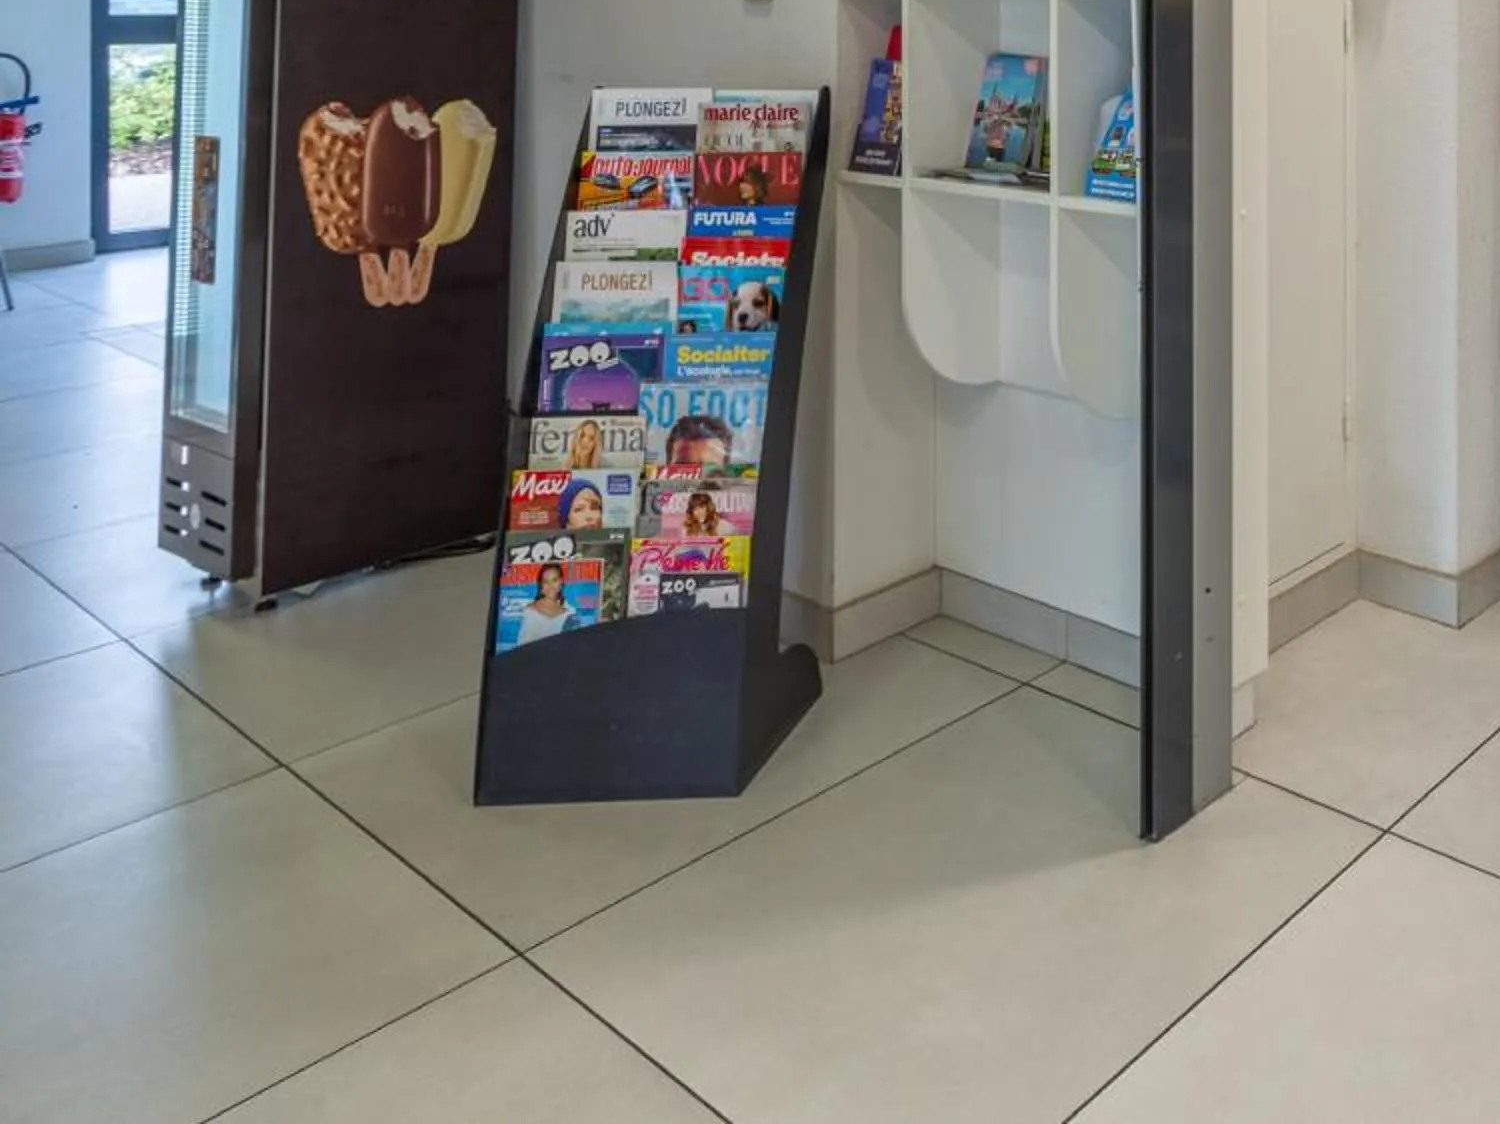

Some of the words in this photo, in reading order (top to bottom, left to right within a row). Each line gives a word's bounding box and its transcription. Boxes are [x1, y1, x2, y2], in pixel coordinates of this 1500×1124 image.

[703, 104, 752, 122] marie
[754, 104, 799, 122] claire
[693, 211, 757, 226] FUTURA
[676, 344, 769, 365] Socialter
[639, 387, 676, 428] SO
[688, 388, 767, 427] FOOT
[530, 420, 647, 455] feina
